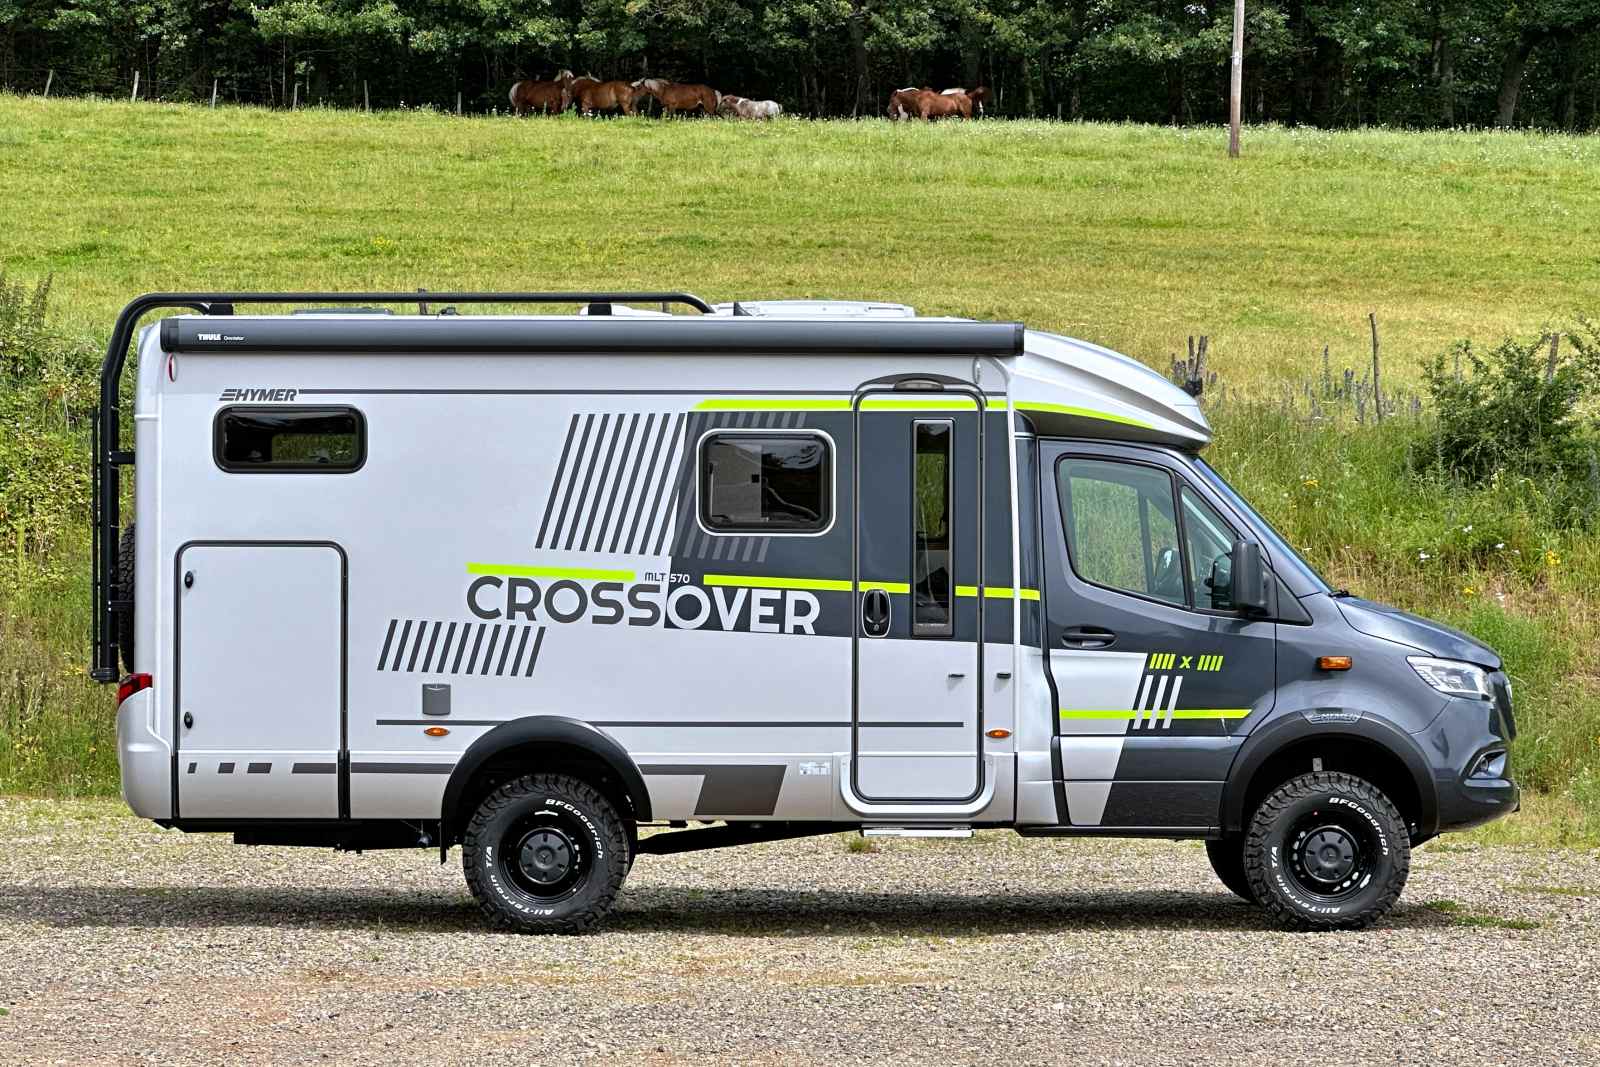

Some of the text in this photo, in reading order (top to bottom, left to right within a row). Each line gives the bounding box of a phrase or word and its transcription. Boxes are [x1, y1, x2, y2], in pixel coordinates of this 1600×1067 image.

[233, 388, 298, 402] HYMER
[467, 575, 821, 635] CROSSOVER
[644, 572, 690, 584] MLT 570
[545, 798, 603, 859] BFGoodrich
[1329, 797, 1389, 856] BFGoodrich
